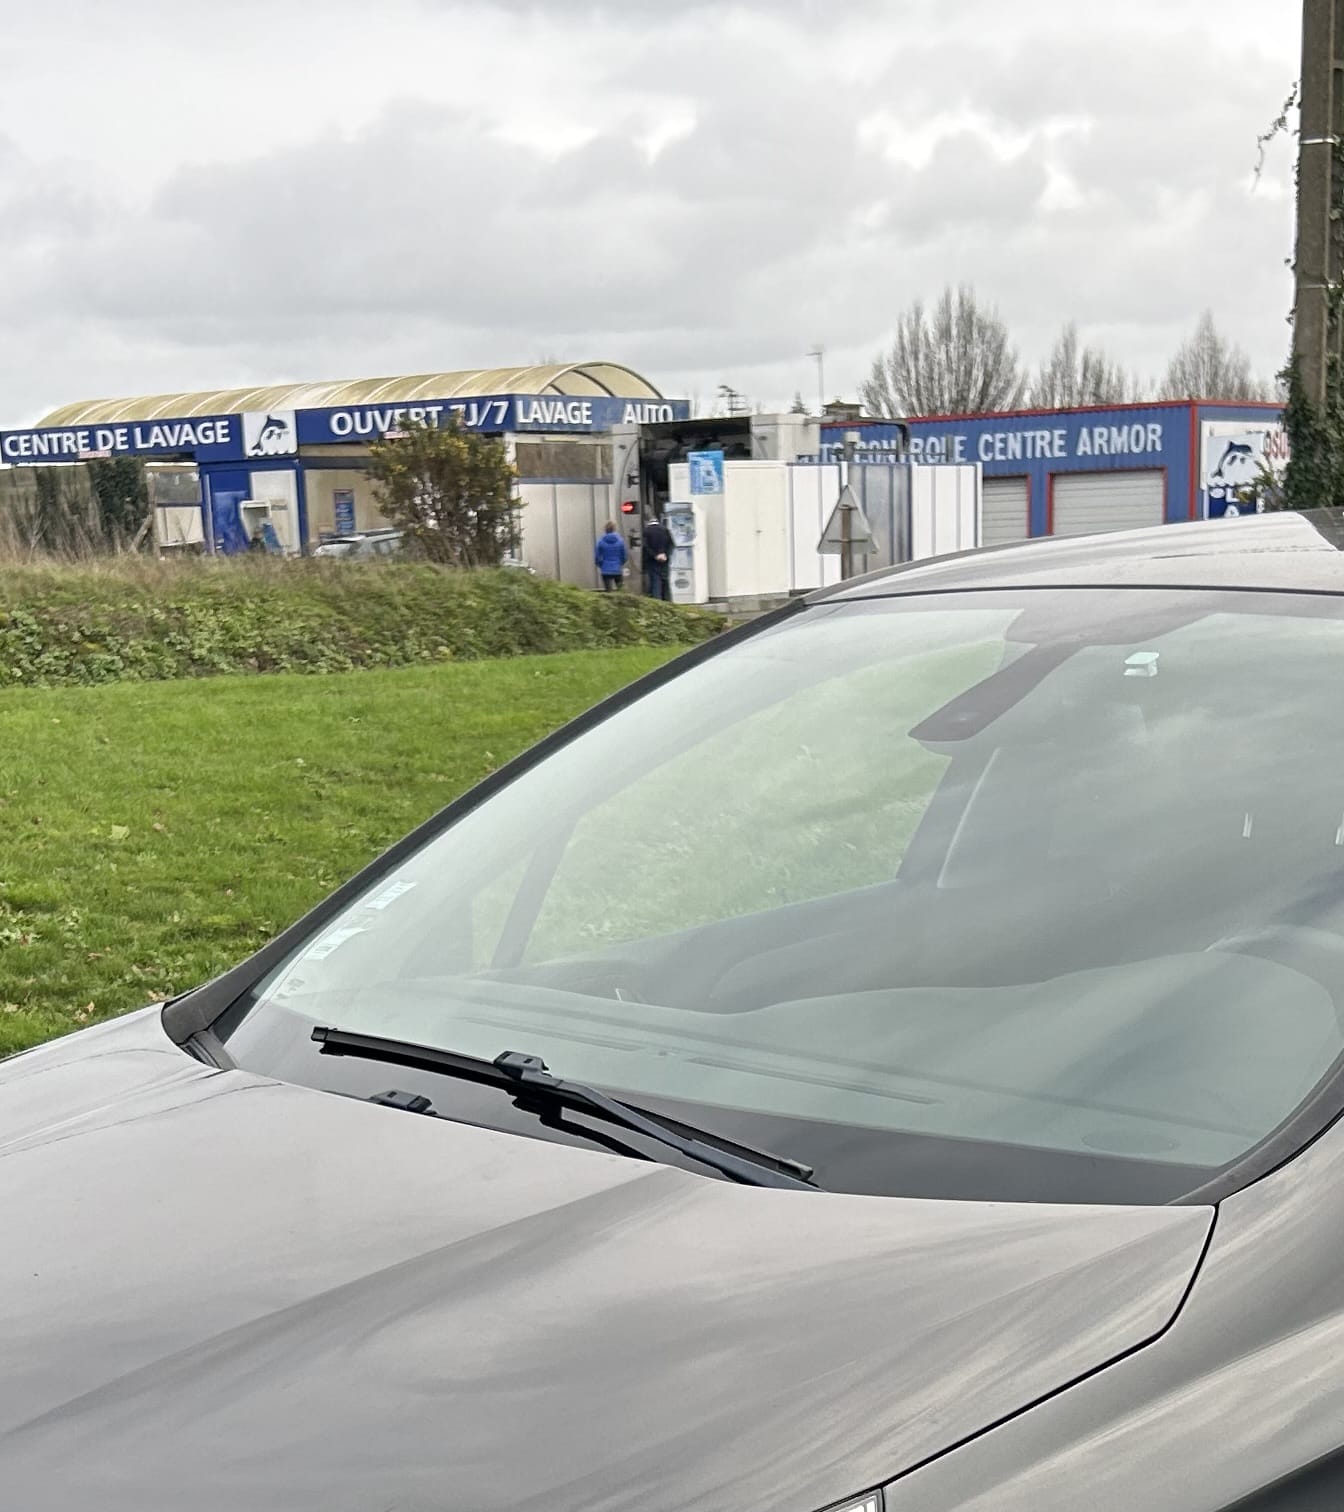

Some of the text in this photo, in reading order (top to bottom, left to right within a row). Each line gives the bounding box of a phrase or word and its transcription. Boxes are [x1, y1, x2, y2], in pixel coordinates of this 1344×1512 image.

[330, 405, 444, 435] OUVERT
[517, 400, 674, 425] LAVAGE AUTO
[4, 421, 231, 457] CENTRE DE LAVAGE
[978, 430, 1067, 462] CENTRE
[1076, 423, 1163, 457] ARMOR
